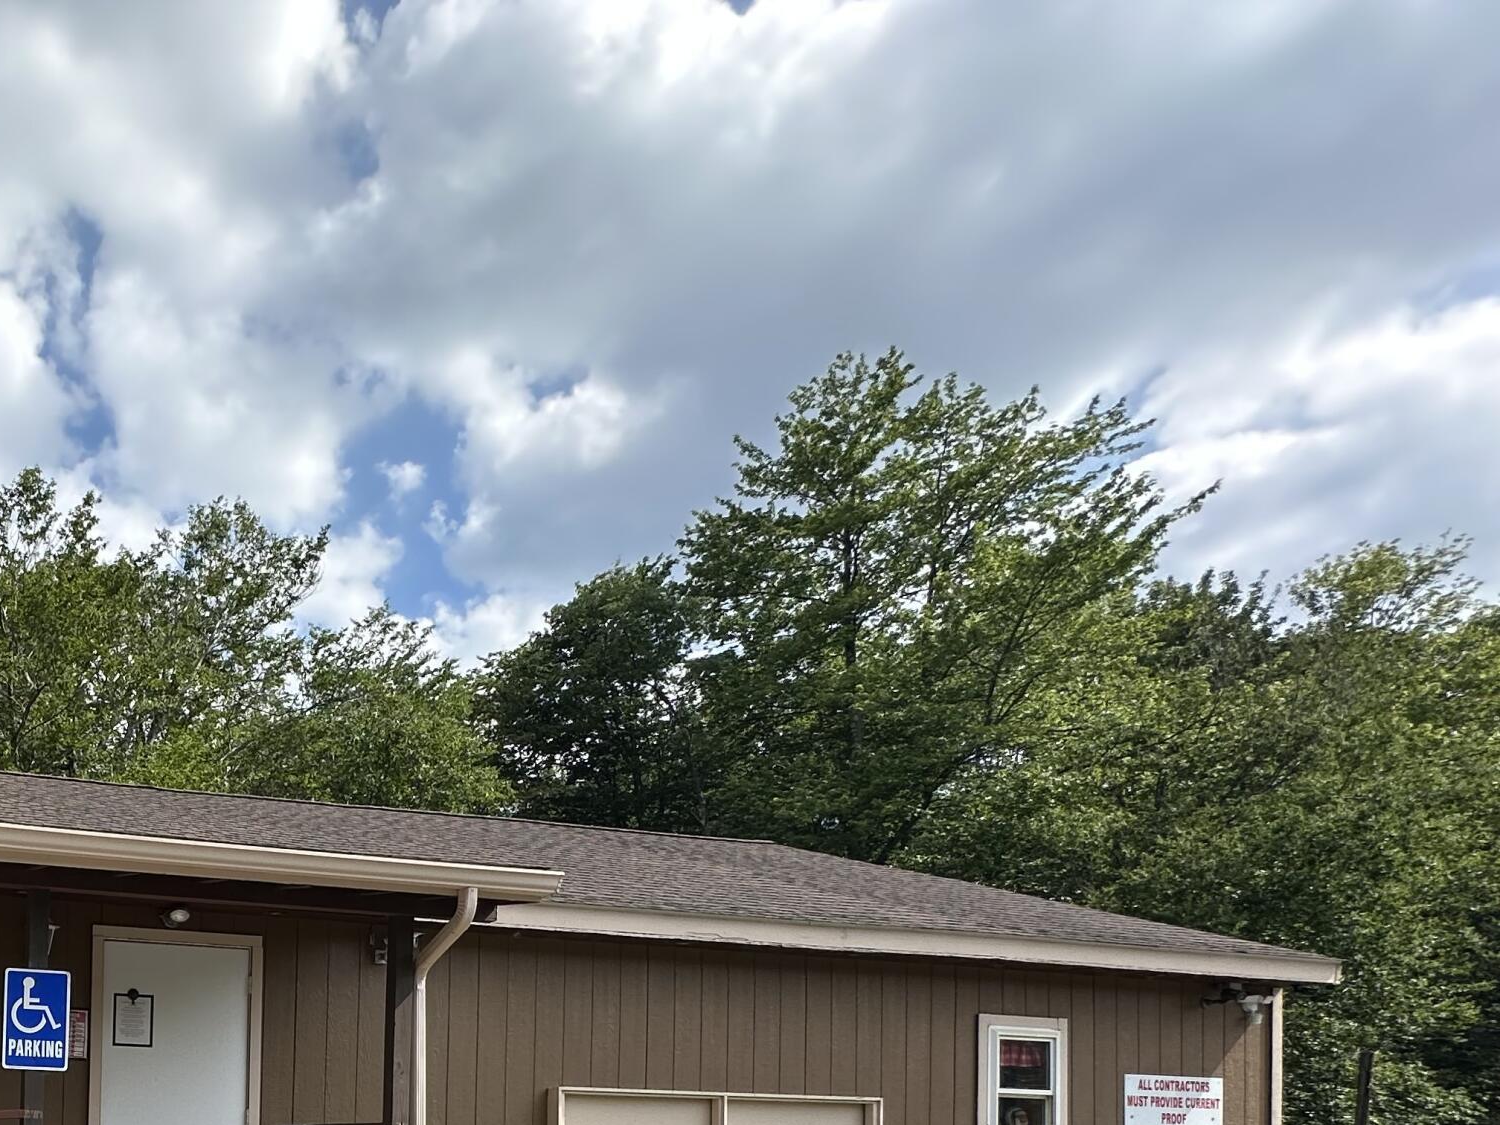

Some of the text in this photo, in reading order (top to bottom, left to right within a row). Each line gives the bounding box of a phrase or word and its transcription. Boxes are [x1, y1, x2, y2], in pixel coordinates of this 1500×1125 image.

[8, 1038, 63, 1059] PARKING
[1138, 1079, 1210, 1092] ALL CONTRACTORS
[1127, 1095, 1220, 1109] MUST PROVIDE CURRENT
[1161, 1113, 1187, 1124] PROOF
